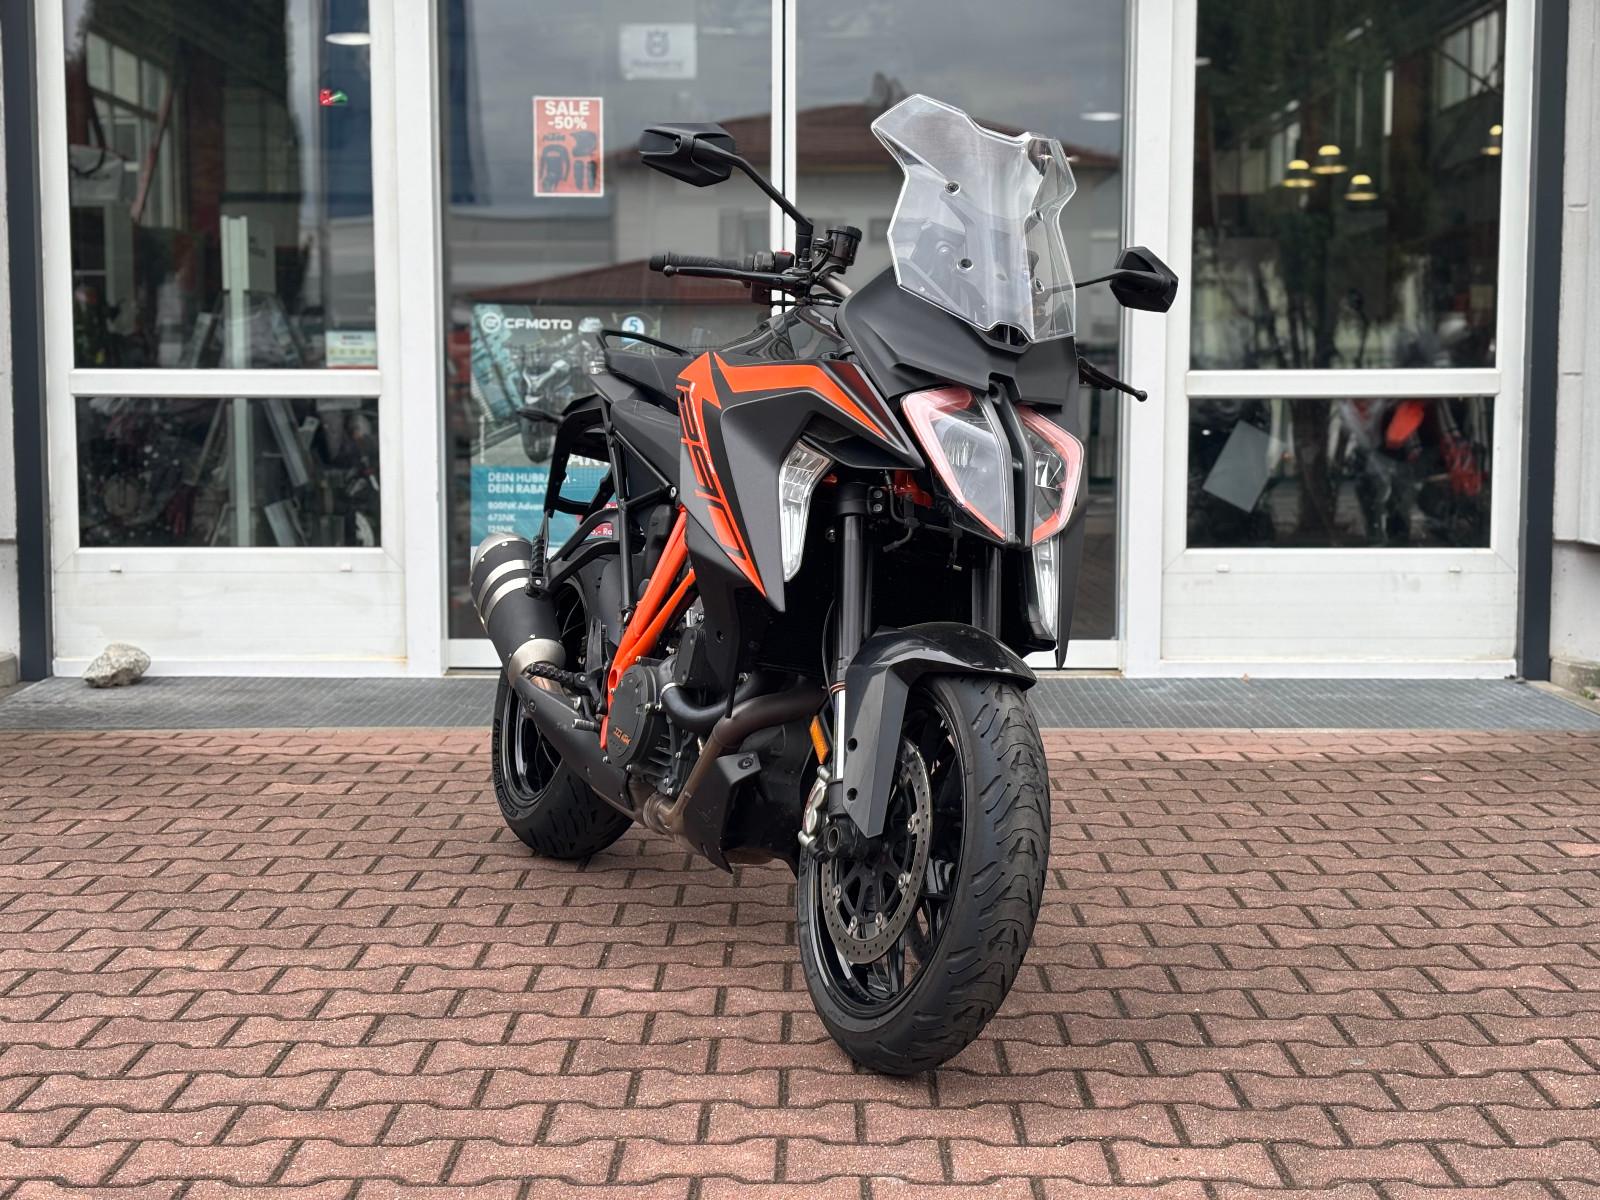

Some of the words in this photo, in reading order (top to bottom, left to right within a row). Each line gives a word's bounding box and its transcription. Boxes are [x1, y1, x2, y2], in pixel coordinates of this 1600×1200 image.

[544, 100, 590, 116] SALE
[547, 116, 588, 129] -50%
[503, 318, 573, 330] CFMOTO
[487, 472, 514, 483] DEIN
[487, 483, 514, 494] DEIN
